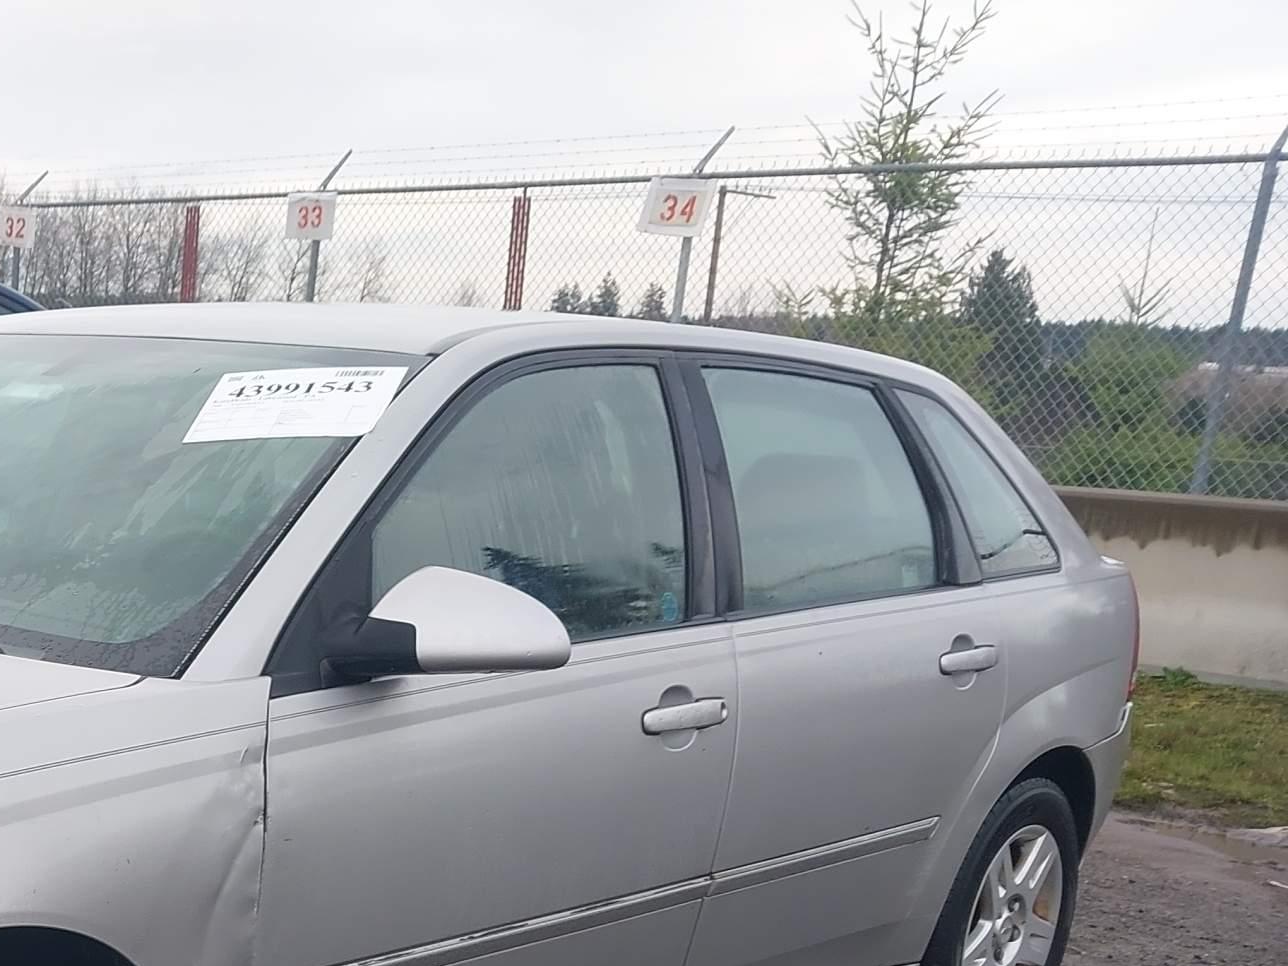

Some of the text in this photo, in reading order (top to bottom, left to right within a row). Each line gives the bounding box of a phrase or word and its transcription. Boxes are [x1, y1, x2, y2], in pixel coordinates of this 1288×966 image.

[297, 205, 323, 229] 33
[660, 193, 698, 224] 34
[5, 217, 26, 239] 32
[228, 380, 374, 398] 43991543
